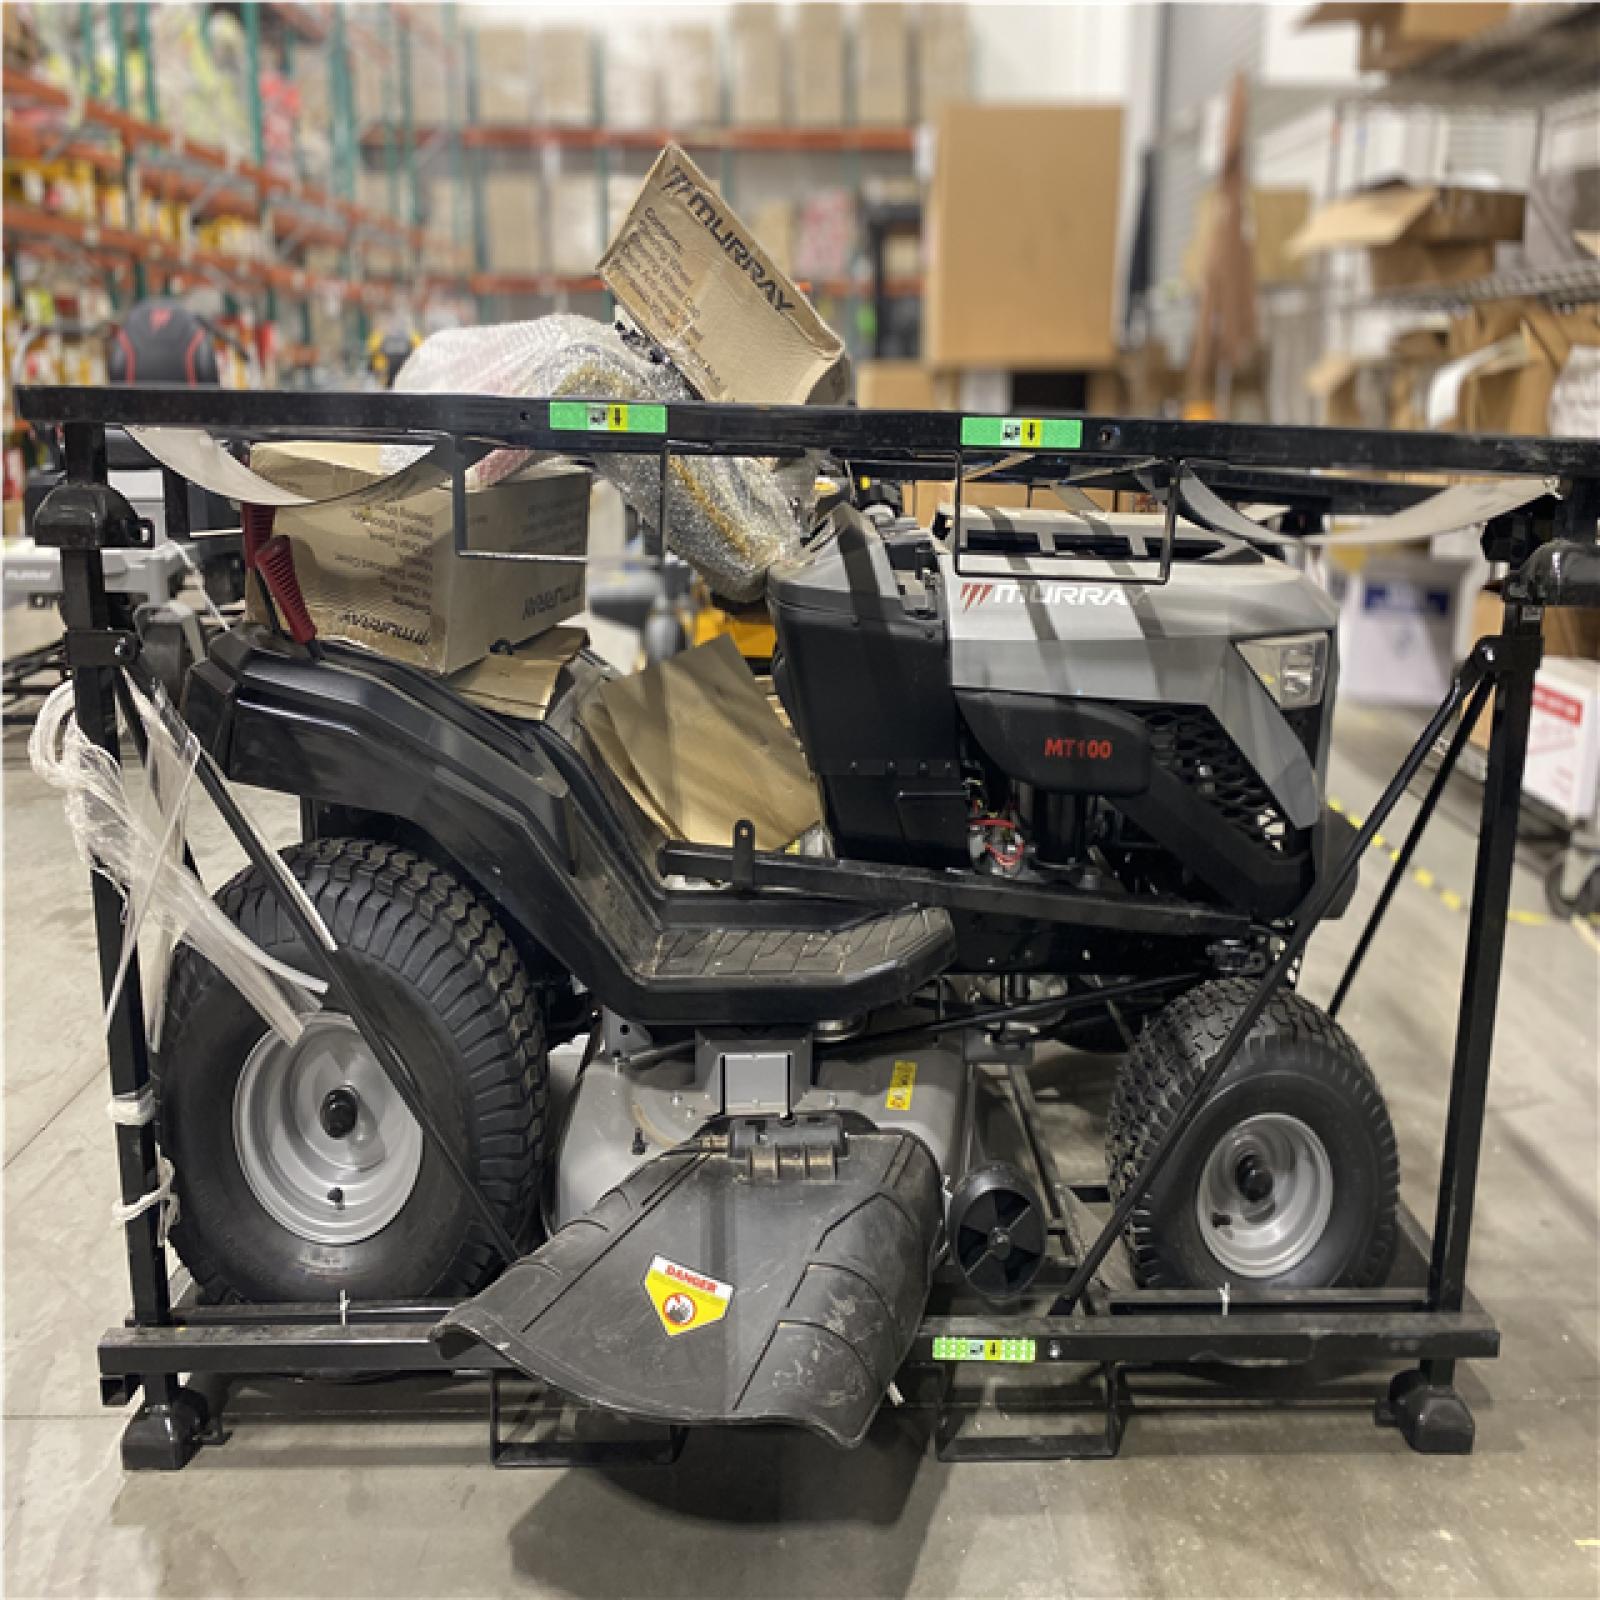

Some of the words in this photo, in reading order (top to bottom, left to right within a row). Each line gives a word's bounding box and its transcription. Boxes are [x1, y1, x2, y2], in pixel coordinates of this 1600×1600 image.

[688, 193, 795, 312] MURRAY
[1044, 737, 1113, 760] MT100
[664, 1264, 718, 1294] DANGER
